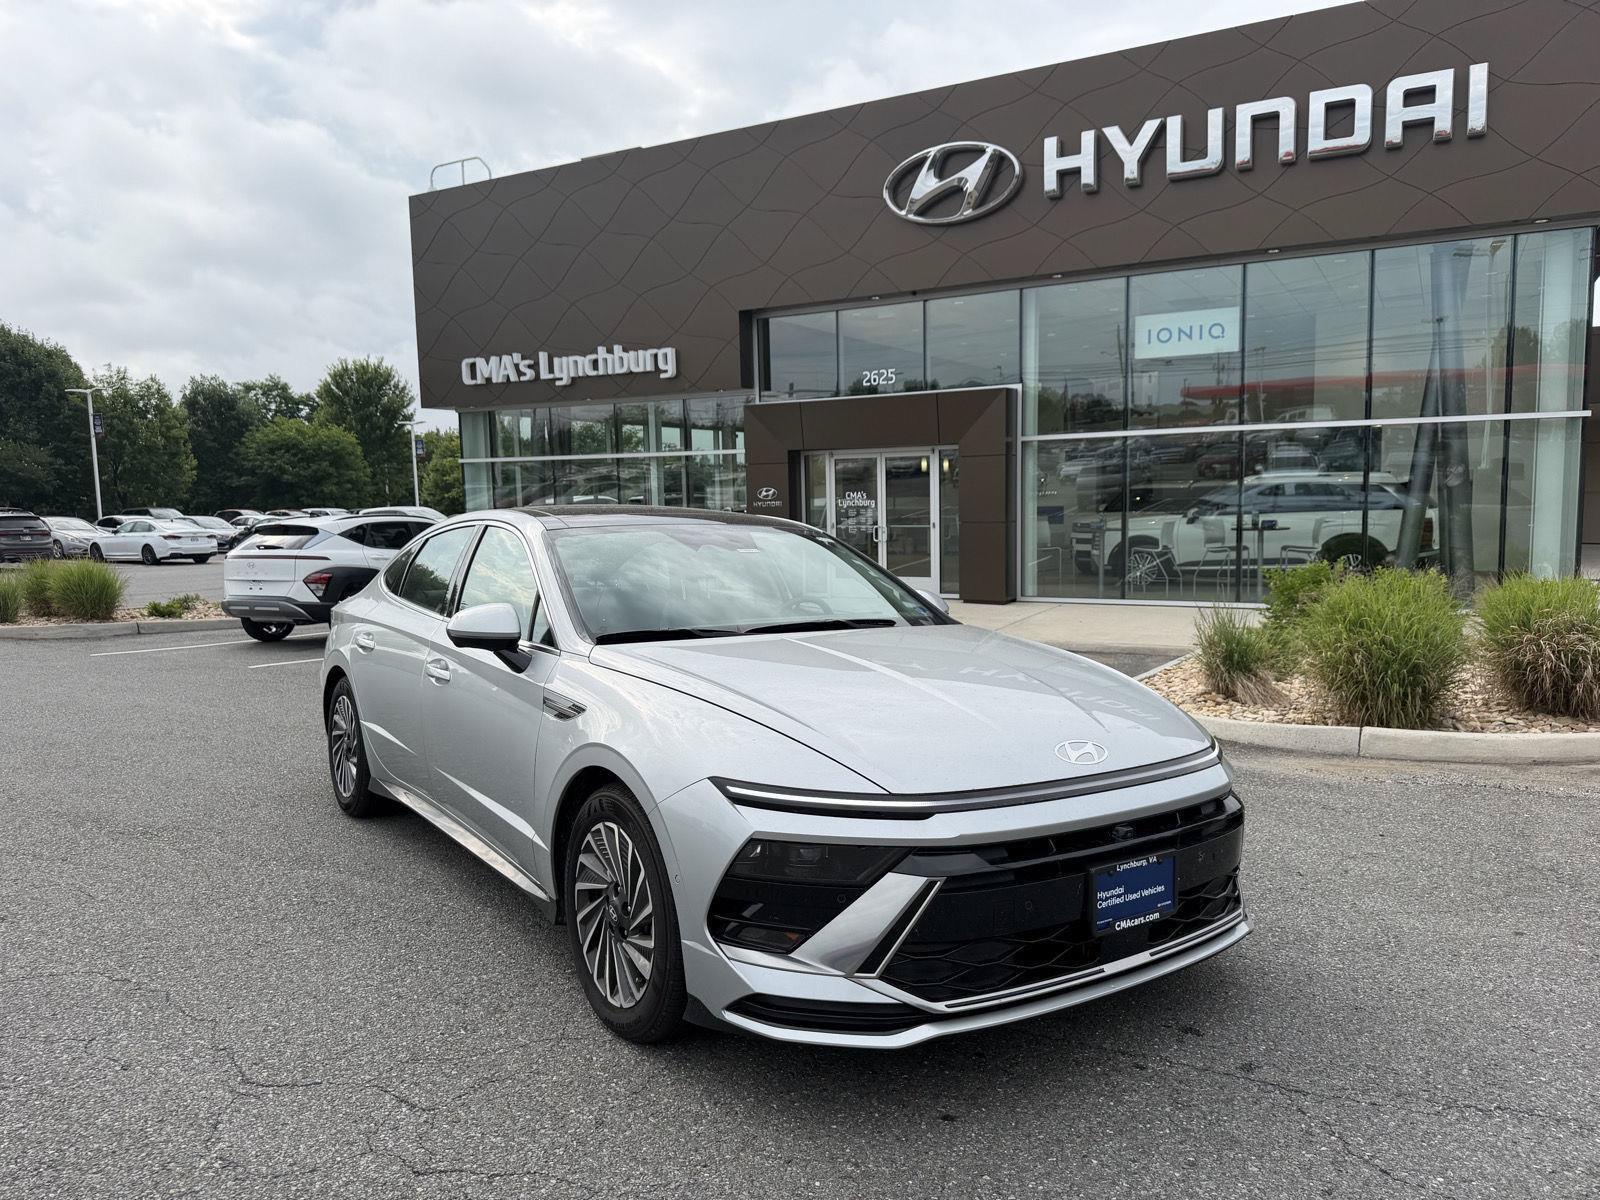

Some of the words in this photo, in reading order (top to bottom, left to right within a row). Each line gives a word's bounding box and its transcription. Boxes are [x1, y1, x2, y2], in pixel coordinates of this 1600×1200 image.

[1043, 62, 1489, 199] HYUNDAI
[1147, 322, 1225, 345] IONIQ
[461, 352, 536, 386] CMA's
[538, 344, 677, 387] Lynchburg
[862, 368, 896, 387] 2625
[838, 499, 876, 509] Lynchburg
[845, 491, 867, 500] CMA's
[1116, 858, 1148, 872] Lynchburg,
[1097, 885, 1125, 900] Hyundai
[1097, 895, 1125, 909] Certified
[1125, 890, 1141, 902] Used
[1141, 885, 1165, 897] Vehicles
[1115, 912, 1160, 931] CMAcars.com
